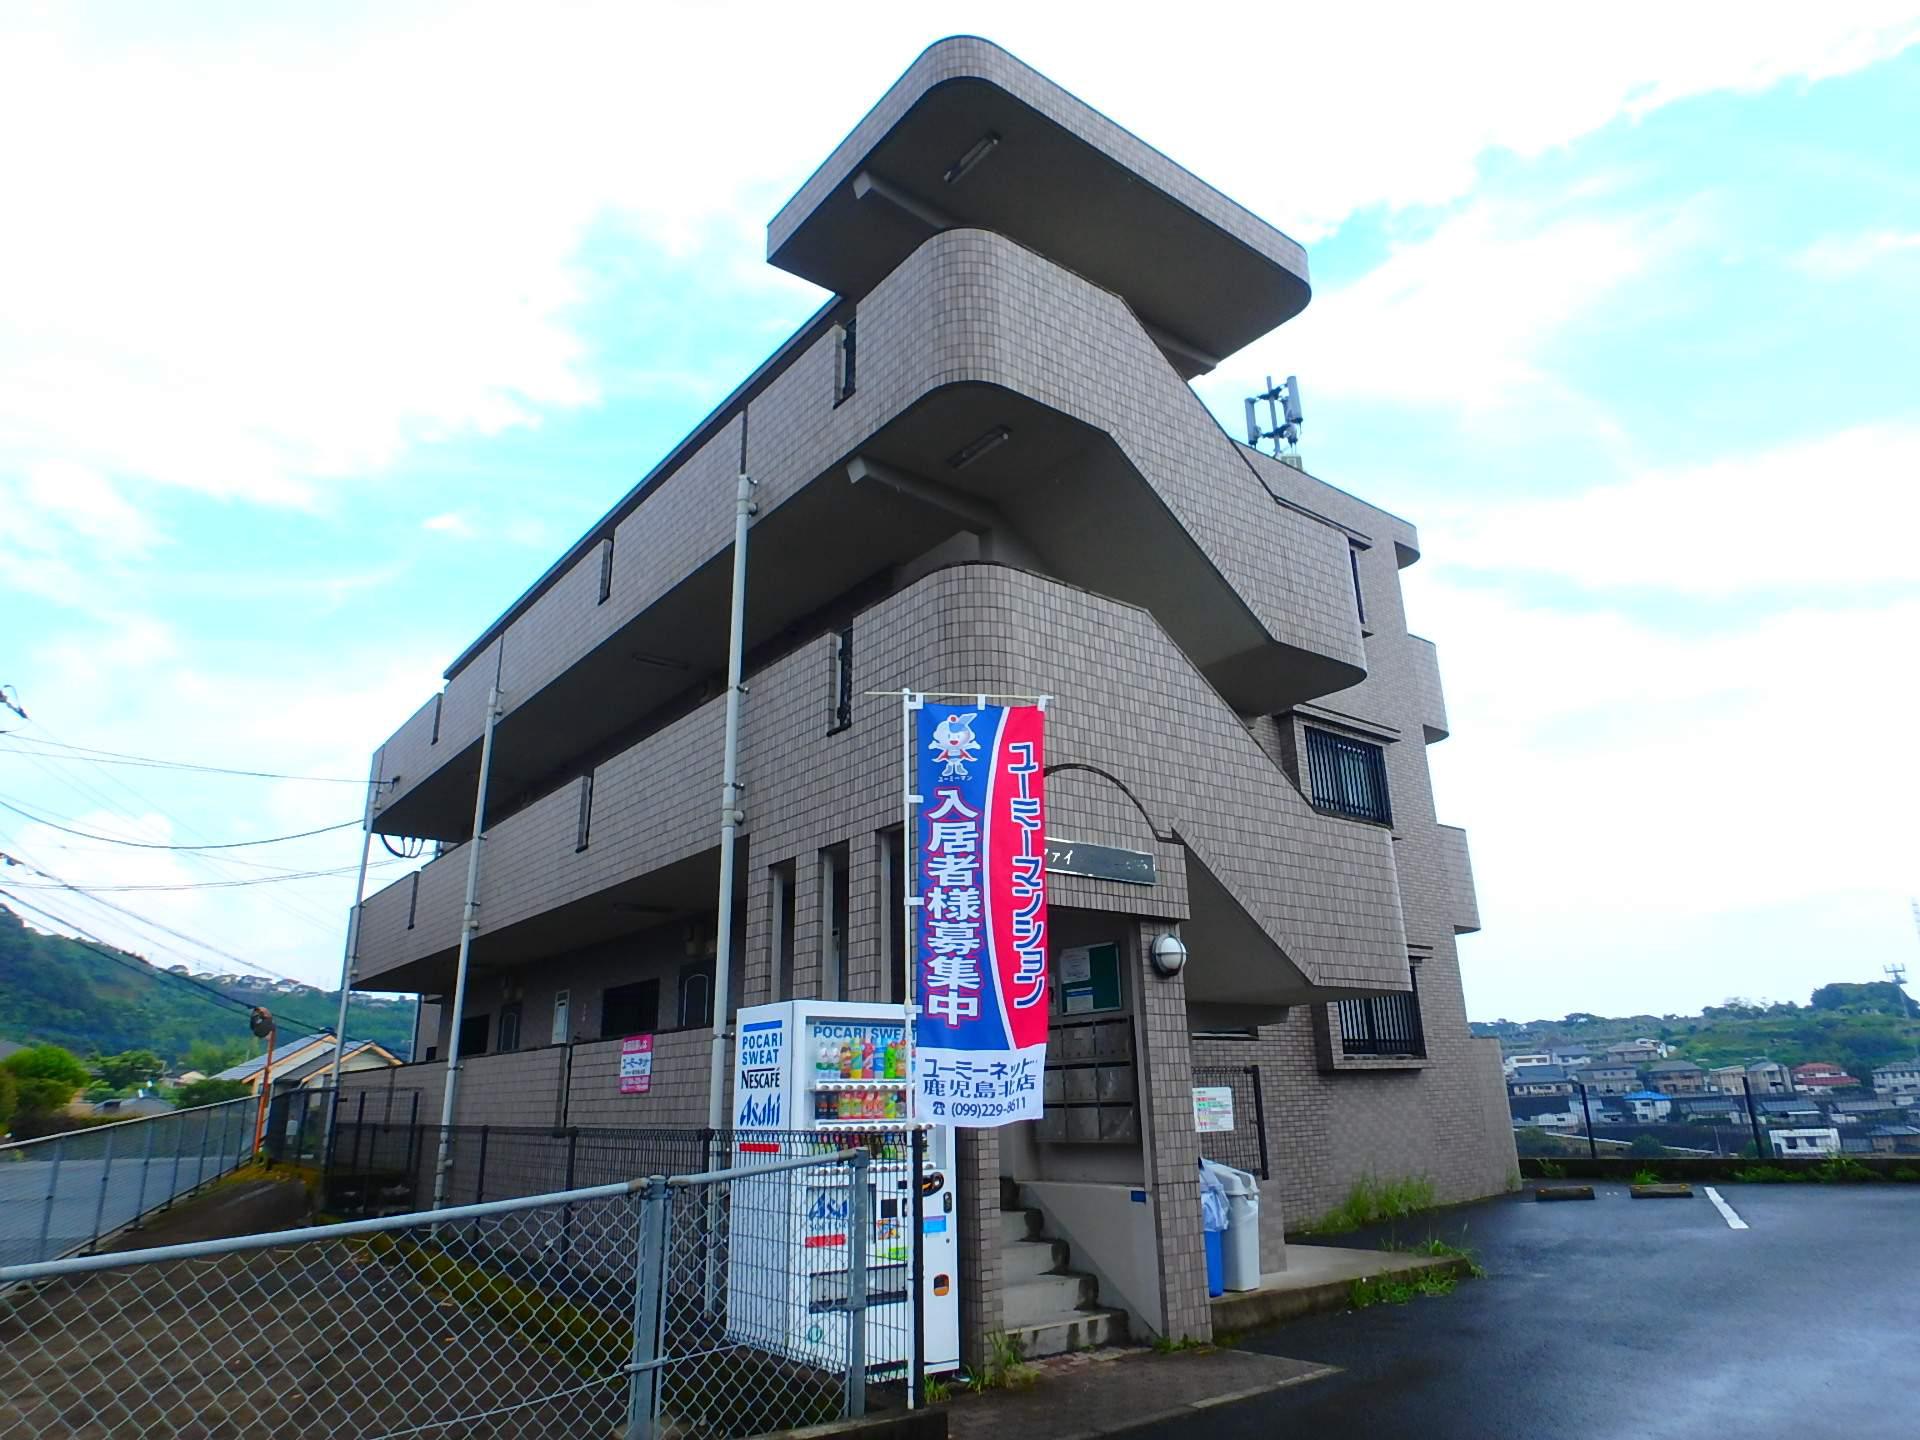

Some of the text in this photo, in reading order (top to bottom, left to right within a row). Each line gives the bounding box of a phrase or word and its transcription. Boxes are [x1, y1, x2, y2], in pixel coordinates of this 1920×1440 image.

[1044, 848, 1074, 865] ァイ
[1009, 743, 1044, 1008] ユーミーマンション
[928, 789, 980, 1025] 入居者様募集中
[742, 1031, 782, 1050] POCARI
[813, 1026, 867, 1040] POCARI
[742, 1049, 779, 1066] SWEAT
[923, 1057, 1037, 1080] ユーミーネット
[741, 1067, 780, 1090] NESCAFÉ
[924, 1074, 1037, 1099] 鹿児島北店
[739, 1092, 781, 1126] Asahi
